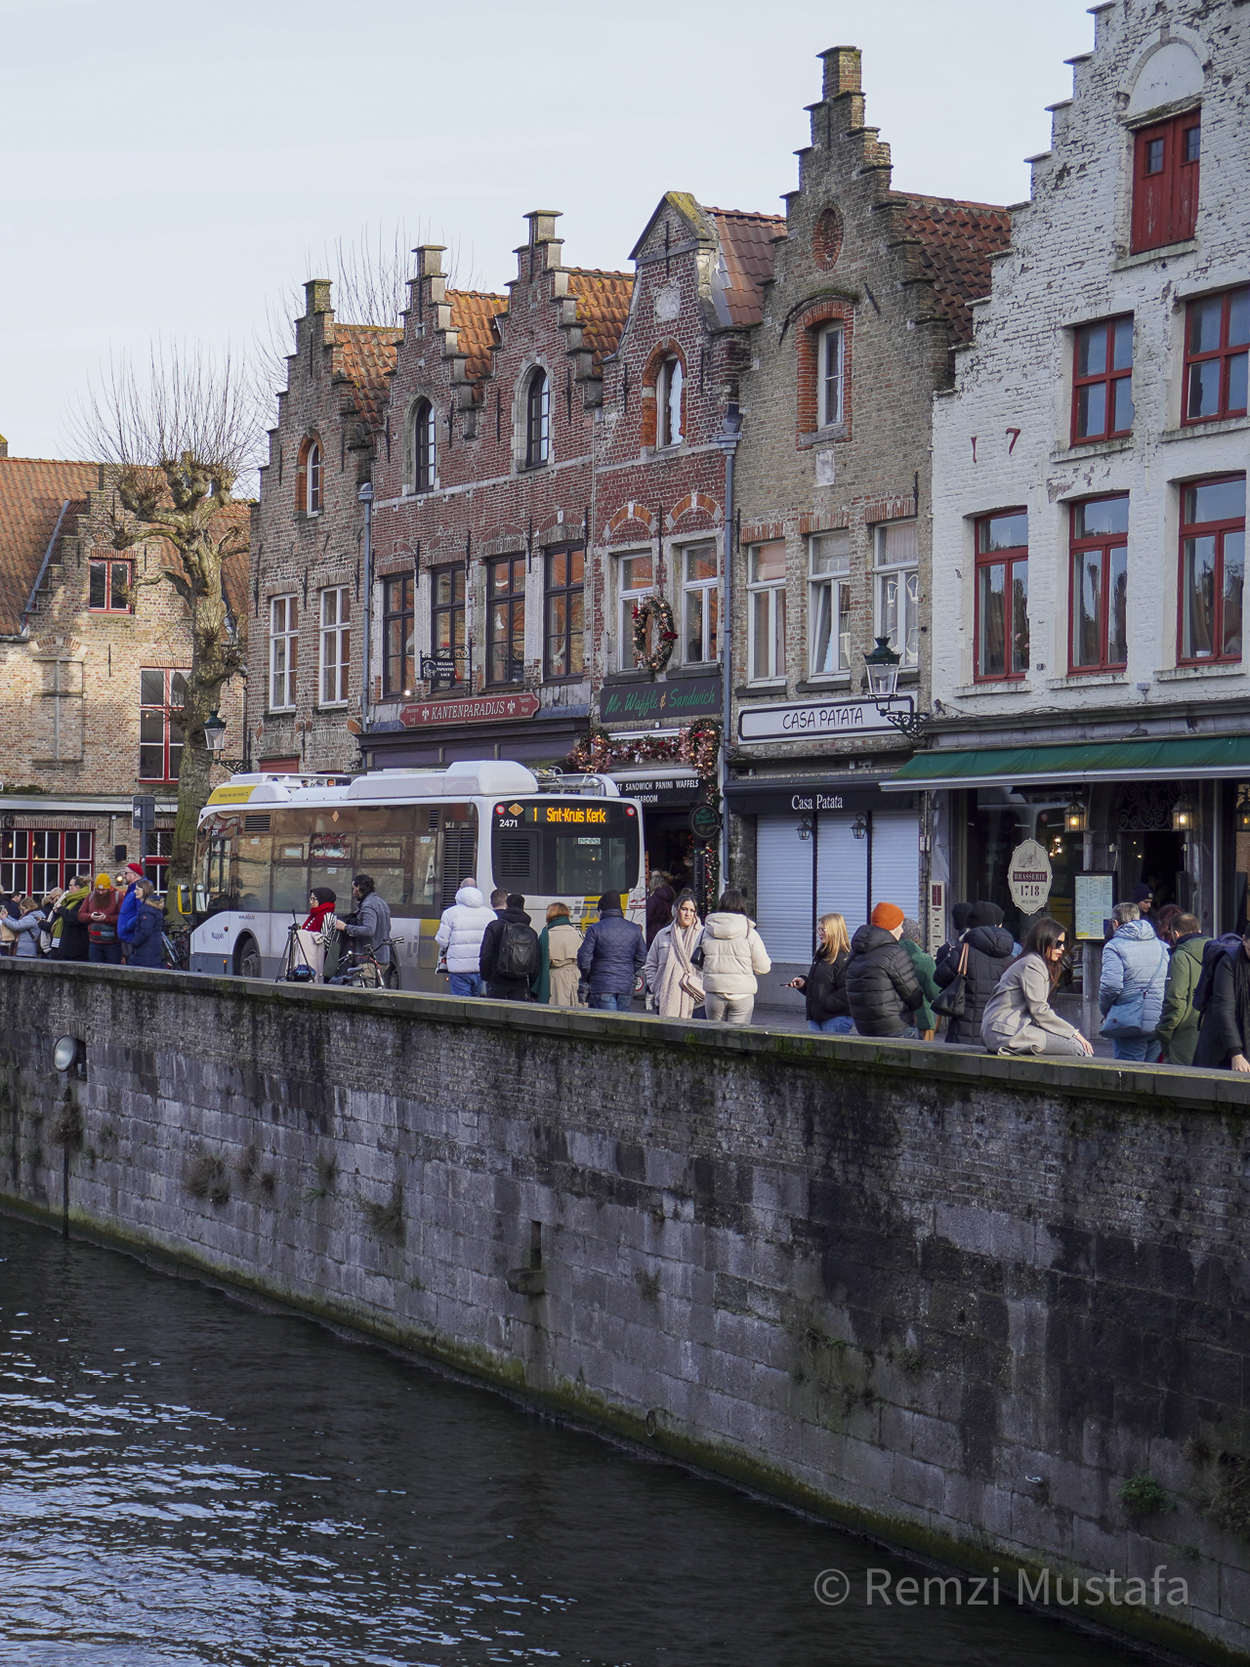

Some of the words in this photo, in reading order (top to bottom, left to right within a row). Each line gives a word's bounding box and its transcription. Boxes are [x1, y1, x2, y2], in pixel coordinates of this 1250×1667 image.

[605, 694, 623, 715] Mr.
[624, 690, 658, 717] Waffle
[668, 684, 716, 708] Sandwich
[431, 701, 506, 720] KANTENPARADIJS
[782, 710, 816, 730] CASA
[819, 707, 864, 727] PATATA
[625, 781, 653, 791] SANDWICH
[655, 780, 674, 790] PANINI
[675, 779, 699, 788] WAFFELS
[791, 794, 813, 810] Casa
[816, 794, 843, 809] Patata
[499, 819, 518, 827] 2471
[533, 807, 538, 822] 1
[546, 807, 585, 822] Sint-Kruis
[586, 808, 606, 823] Kerk
[1020, 885, 1040, 896] 1718
